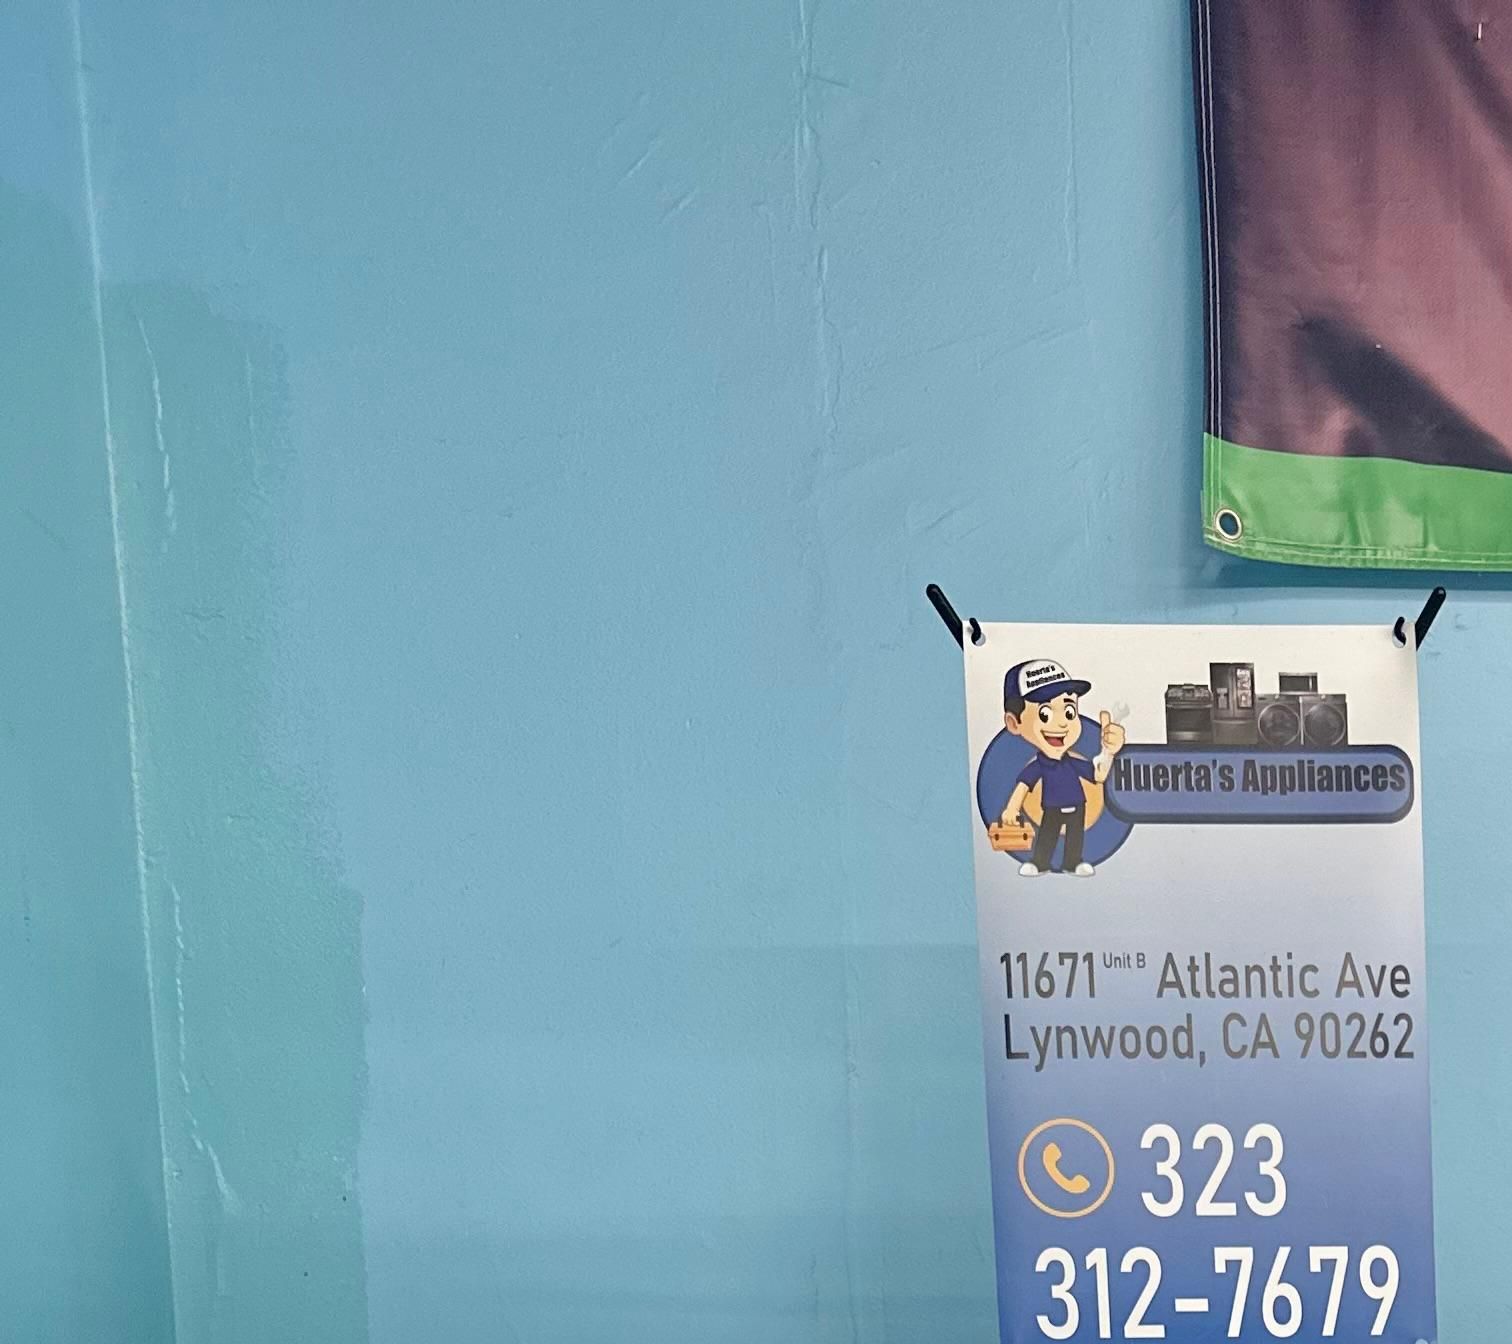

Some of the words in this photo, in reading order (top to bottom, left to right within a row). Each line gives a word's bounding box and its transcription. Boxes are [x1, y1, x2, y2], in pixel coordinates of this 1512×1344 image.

[1114, 759, 1236, 794] Huerta's
[1242, 758, 1406, 795] Appliances
[1000, 952, 1096, 998] 11671
[1102, 952, 1132, 969] Unit
[1136, 953, 1146, 969] B
[1156, 952, 1321, 998] Atlantic
[1335, 952, 1411, 998] Ave
[1004, 1013, 1206, 1072] Lynwood,
[1222, 1012, 1281, 1059] CA
[1294, 1012, 1414, 1059] 90262
[1139, 1123, 1288, 1218] 323
[1034, 1244, 1400, 1340] 312-7679
